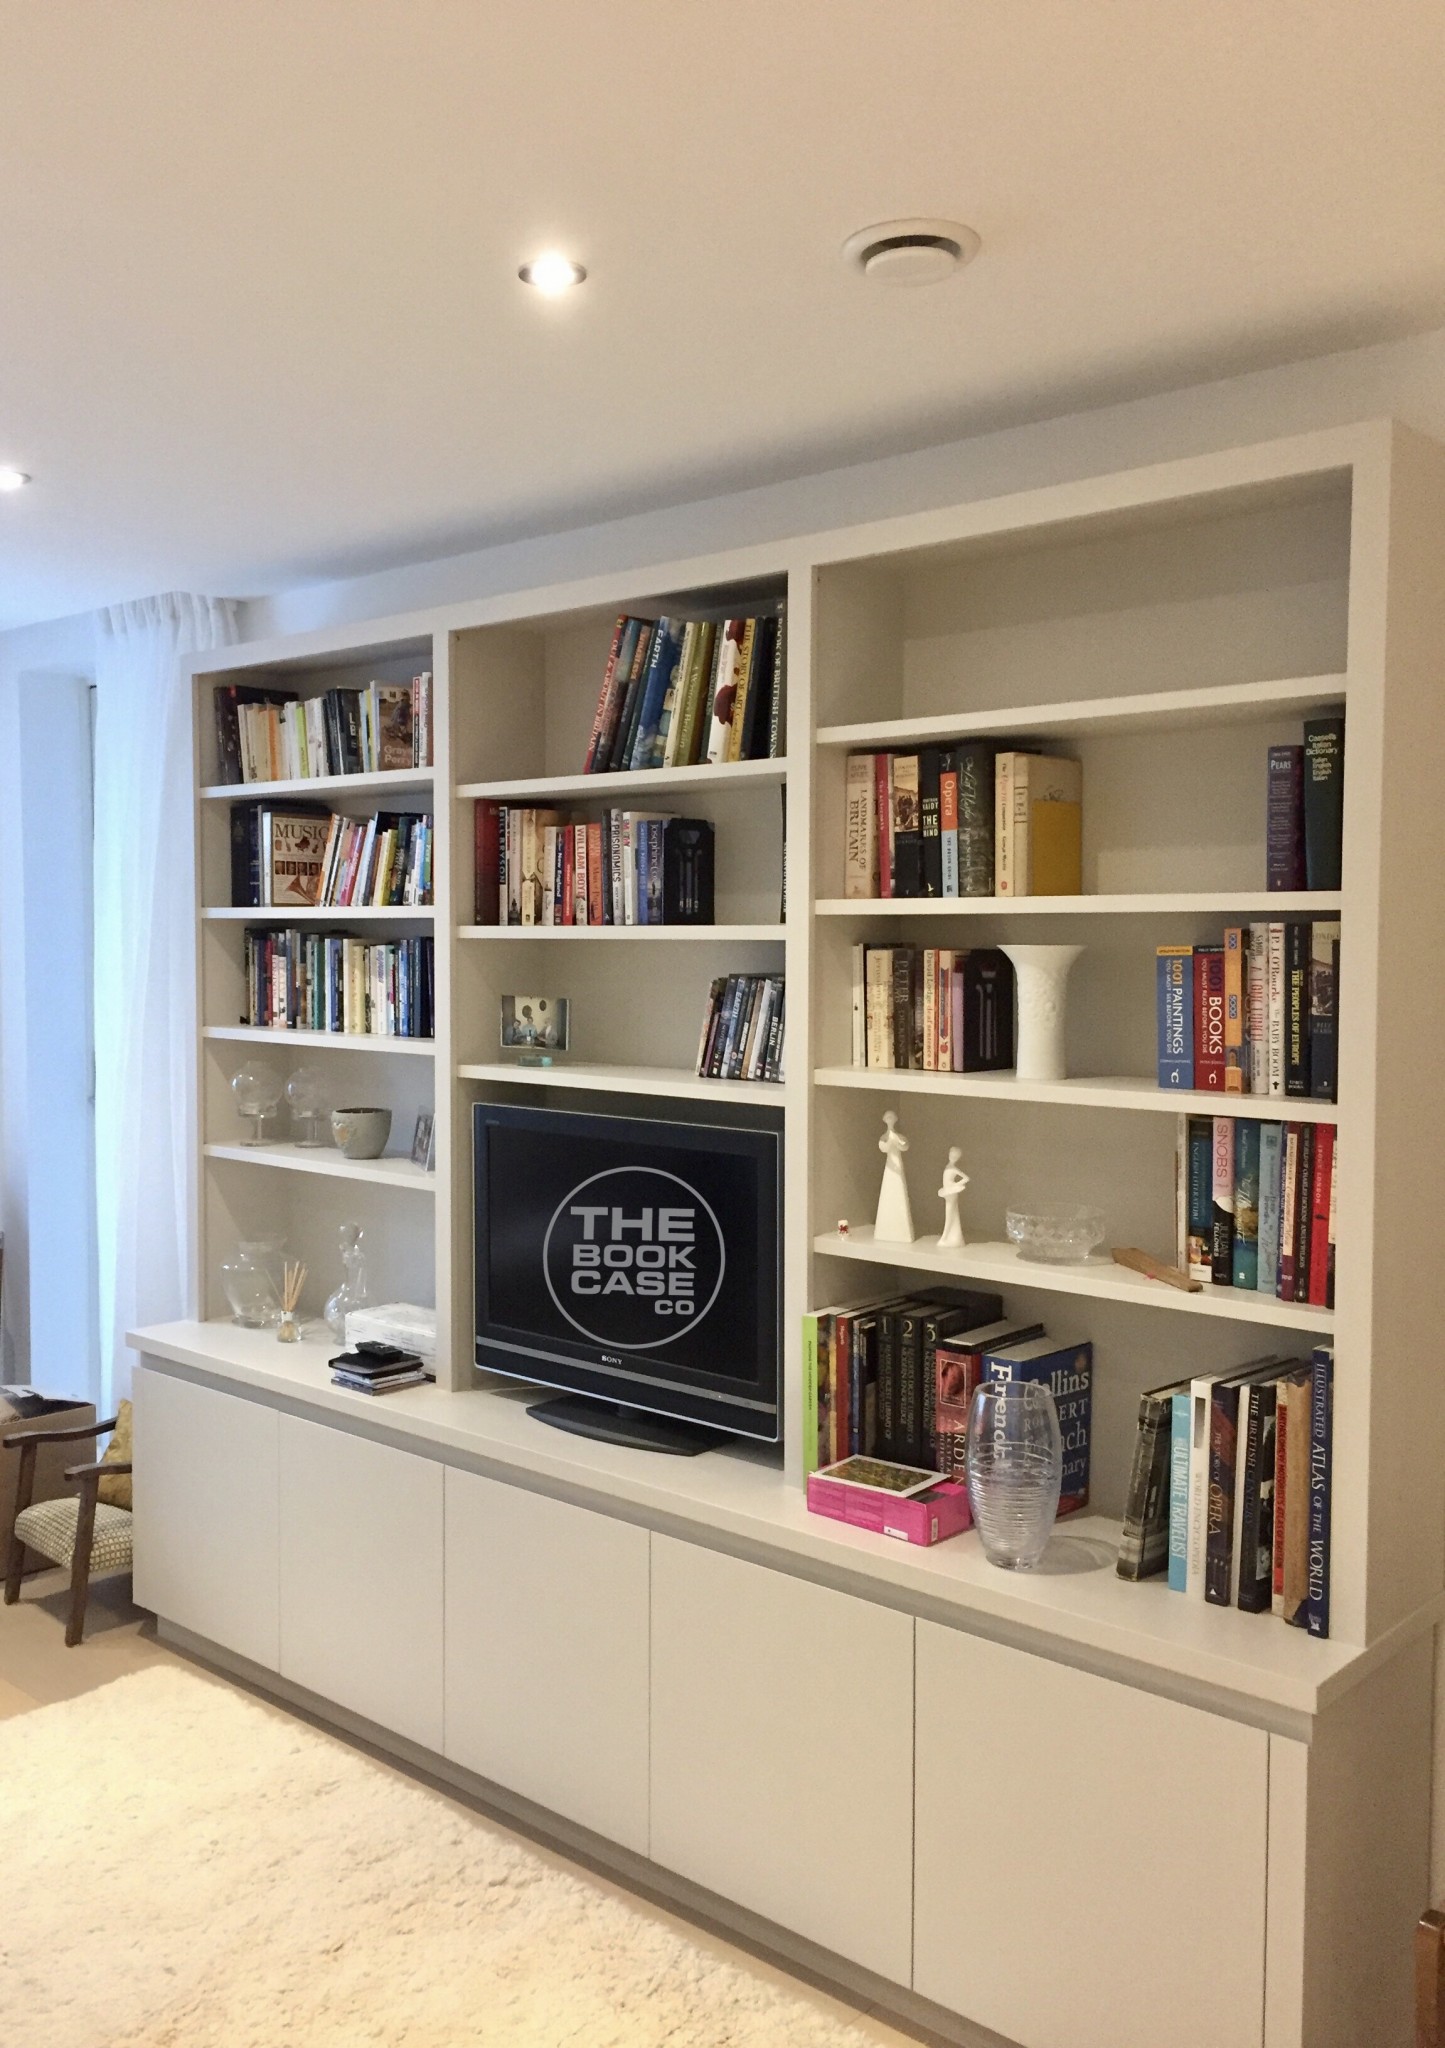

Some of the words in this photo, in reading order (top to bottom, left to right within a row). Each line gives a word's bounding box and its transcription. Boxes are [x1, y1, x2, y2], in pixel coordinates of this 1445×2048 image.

[651, 629, 663, 668] EARTH
[744, 624, 752, 641] THE
[740, 645, 749, 676] STORY
[738, 678, 745, 689] OF
[772, 669, 781, 714] BRITISH
[944, 780, 955, 816] Opera
[275, 823, 329, 840] MUSIC
[850, 800, 859, 862] BRITAIN
[923, 815, 938, 826] THE
[576, 828, 585, 869] WILLIAM
[611, 823, 622, 883] PRISONOMICS
[900, 960, 909, 1003] PETER
[1173, 988, 1183, 1054] PAINTINGS
[1209, 997, 1223, 1054] BOOKS
[1272, 1020, 1280, 1044] BABY
[1292, 1022, 1299, 1033] OF
[1272, 1048, 1280, 1076] BOOM
[1292, 1034, 1300, 1065] EUROPE
[1217, 1125, 1228, 1178] SNOBS
[570, 1206, 695, 1241] THE
[573, 1244, 697, 1268] BOOK
[571, 1270, 695, 1296] CASE
[654, 1300, 695, 1315] CO
[902, 1320, 913, 1338] 2
[926, 1323, 936, 1342] 3
[601, 1355, 622, 1364] SONY
[1249, 1393, 1259, 1416] THE
[1315, 1364, 1325, 1437] ILLUSTRATED
[953, 1420, 965, 1485] ARDEN
[1247, 1419, 1258, 1468] BRITISH
[1172, 1446, 1187, 1499] ULTIMATE
[1213, 1472, 1220, 1481] OF
[1312, 1443, 1326, 1491] ATLAS
[1209, 1484, 1222, 1534] OPERA
[1246, 1471, 1257, 1524] CENTURY
[1315, 1496, 1322, 1508] OF
[1171, 1502, 1186, 1559] TRAVELIST
[1309, 1540, 1324, 1600] WORLD
